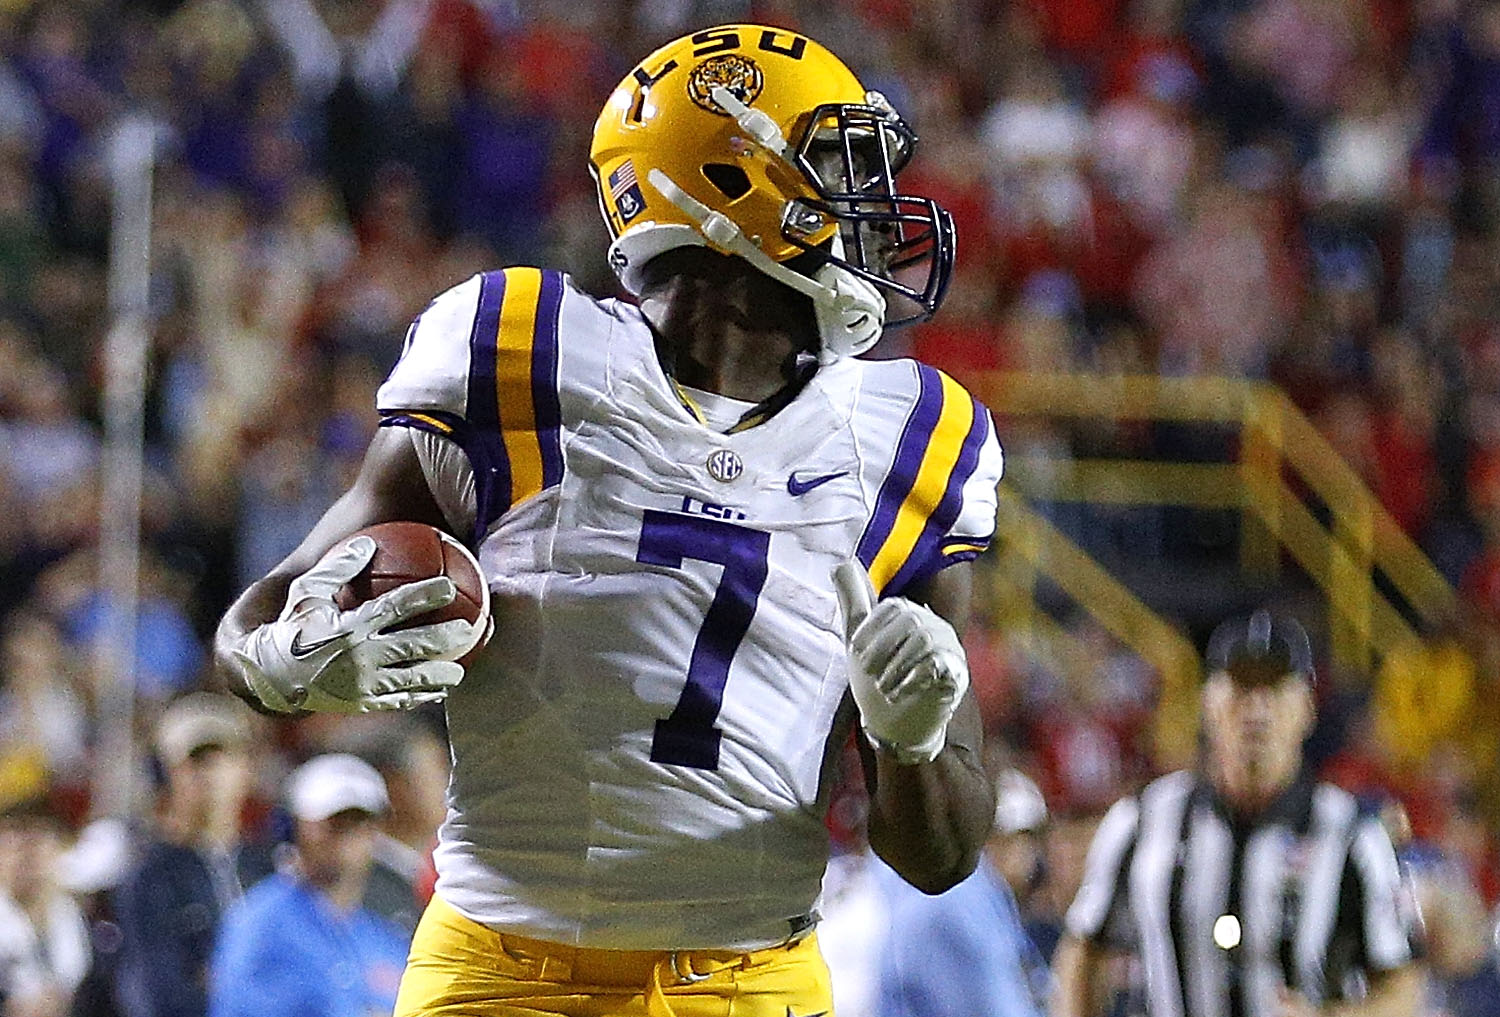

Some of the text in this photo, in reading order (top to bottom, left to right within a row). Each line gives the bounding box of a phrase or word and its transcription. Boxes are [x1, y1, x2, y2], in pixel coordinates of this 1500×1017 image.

[622, 28, 808, 124] LSU
[711, 452, 742, 482] SEC
[636, 509, 772, 770] 7
